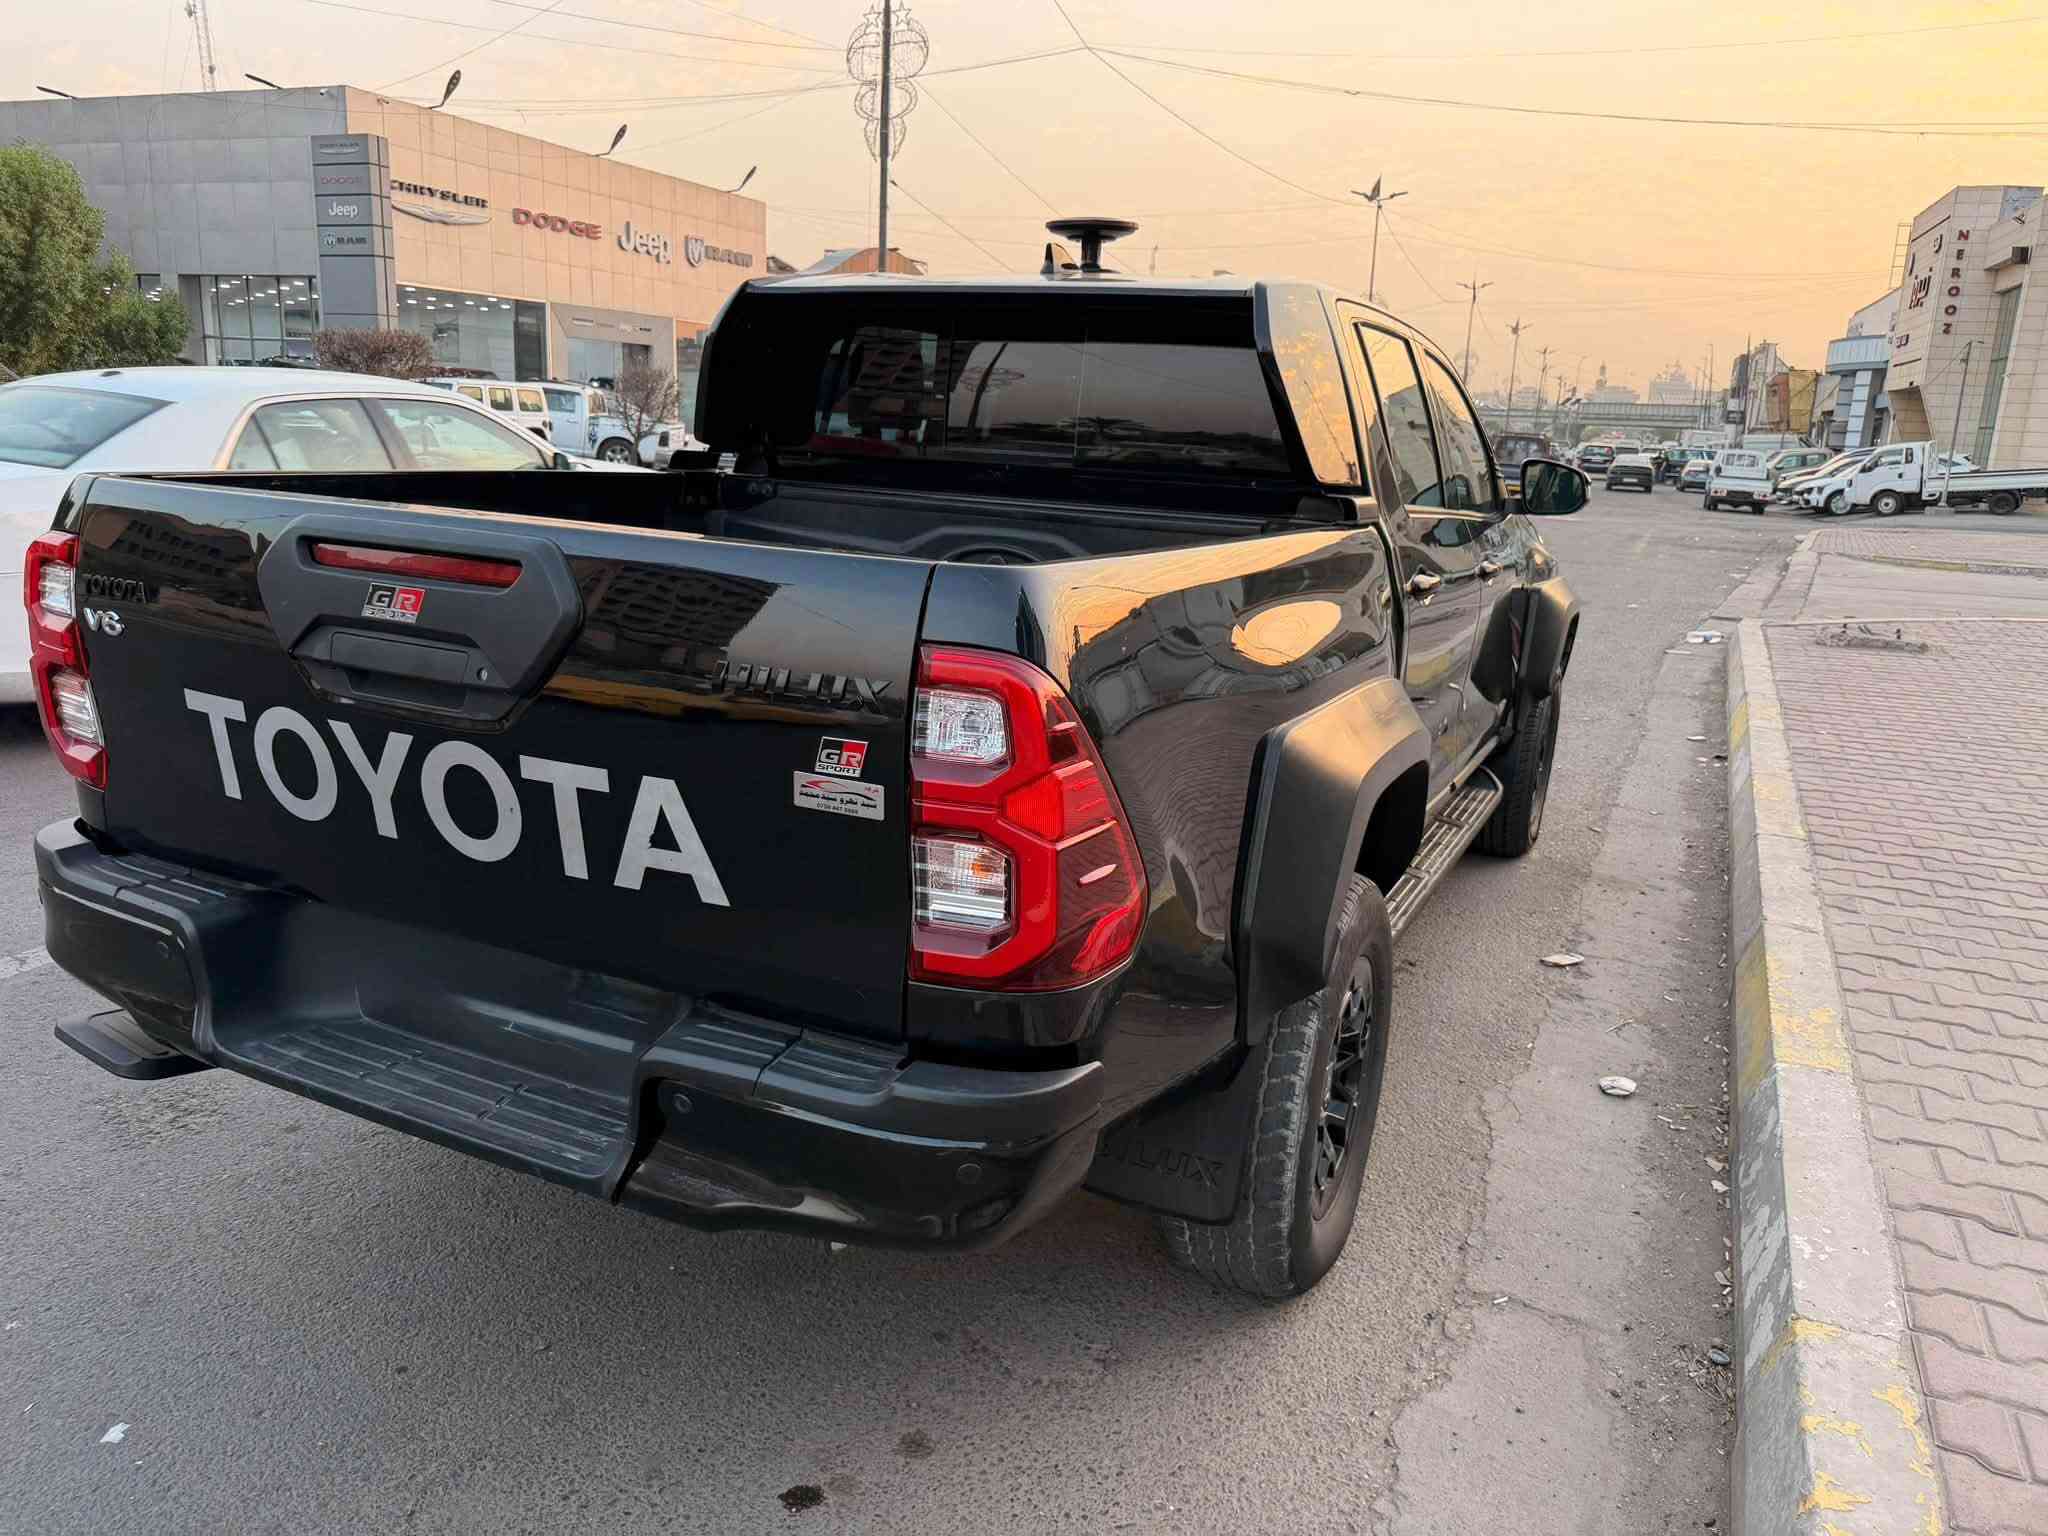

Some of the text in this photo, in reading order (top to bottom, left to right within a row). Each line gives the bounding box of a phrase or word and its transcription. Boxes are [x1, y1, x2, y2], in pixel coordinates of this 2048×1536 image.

[328, 201, 358, 218] Jeep
[512, 207, 603, 240] DODGE
[617, 221, 672, 265] Jeep
[1942, 229, 1970, 335] NEROOZ
[80, 573, 146, 604] TOYOTA
[371, 590, 417, 611] GR
[82, 608, 124, 637] V6
[817, 763, 858, 775] SPORT
[820, 748, 862, 768] GR
[184, 688, 730, 907] TOYOTA
